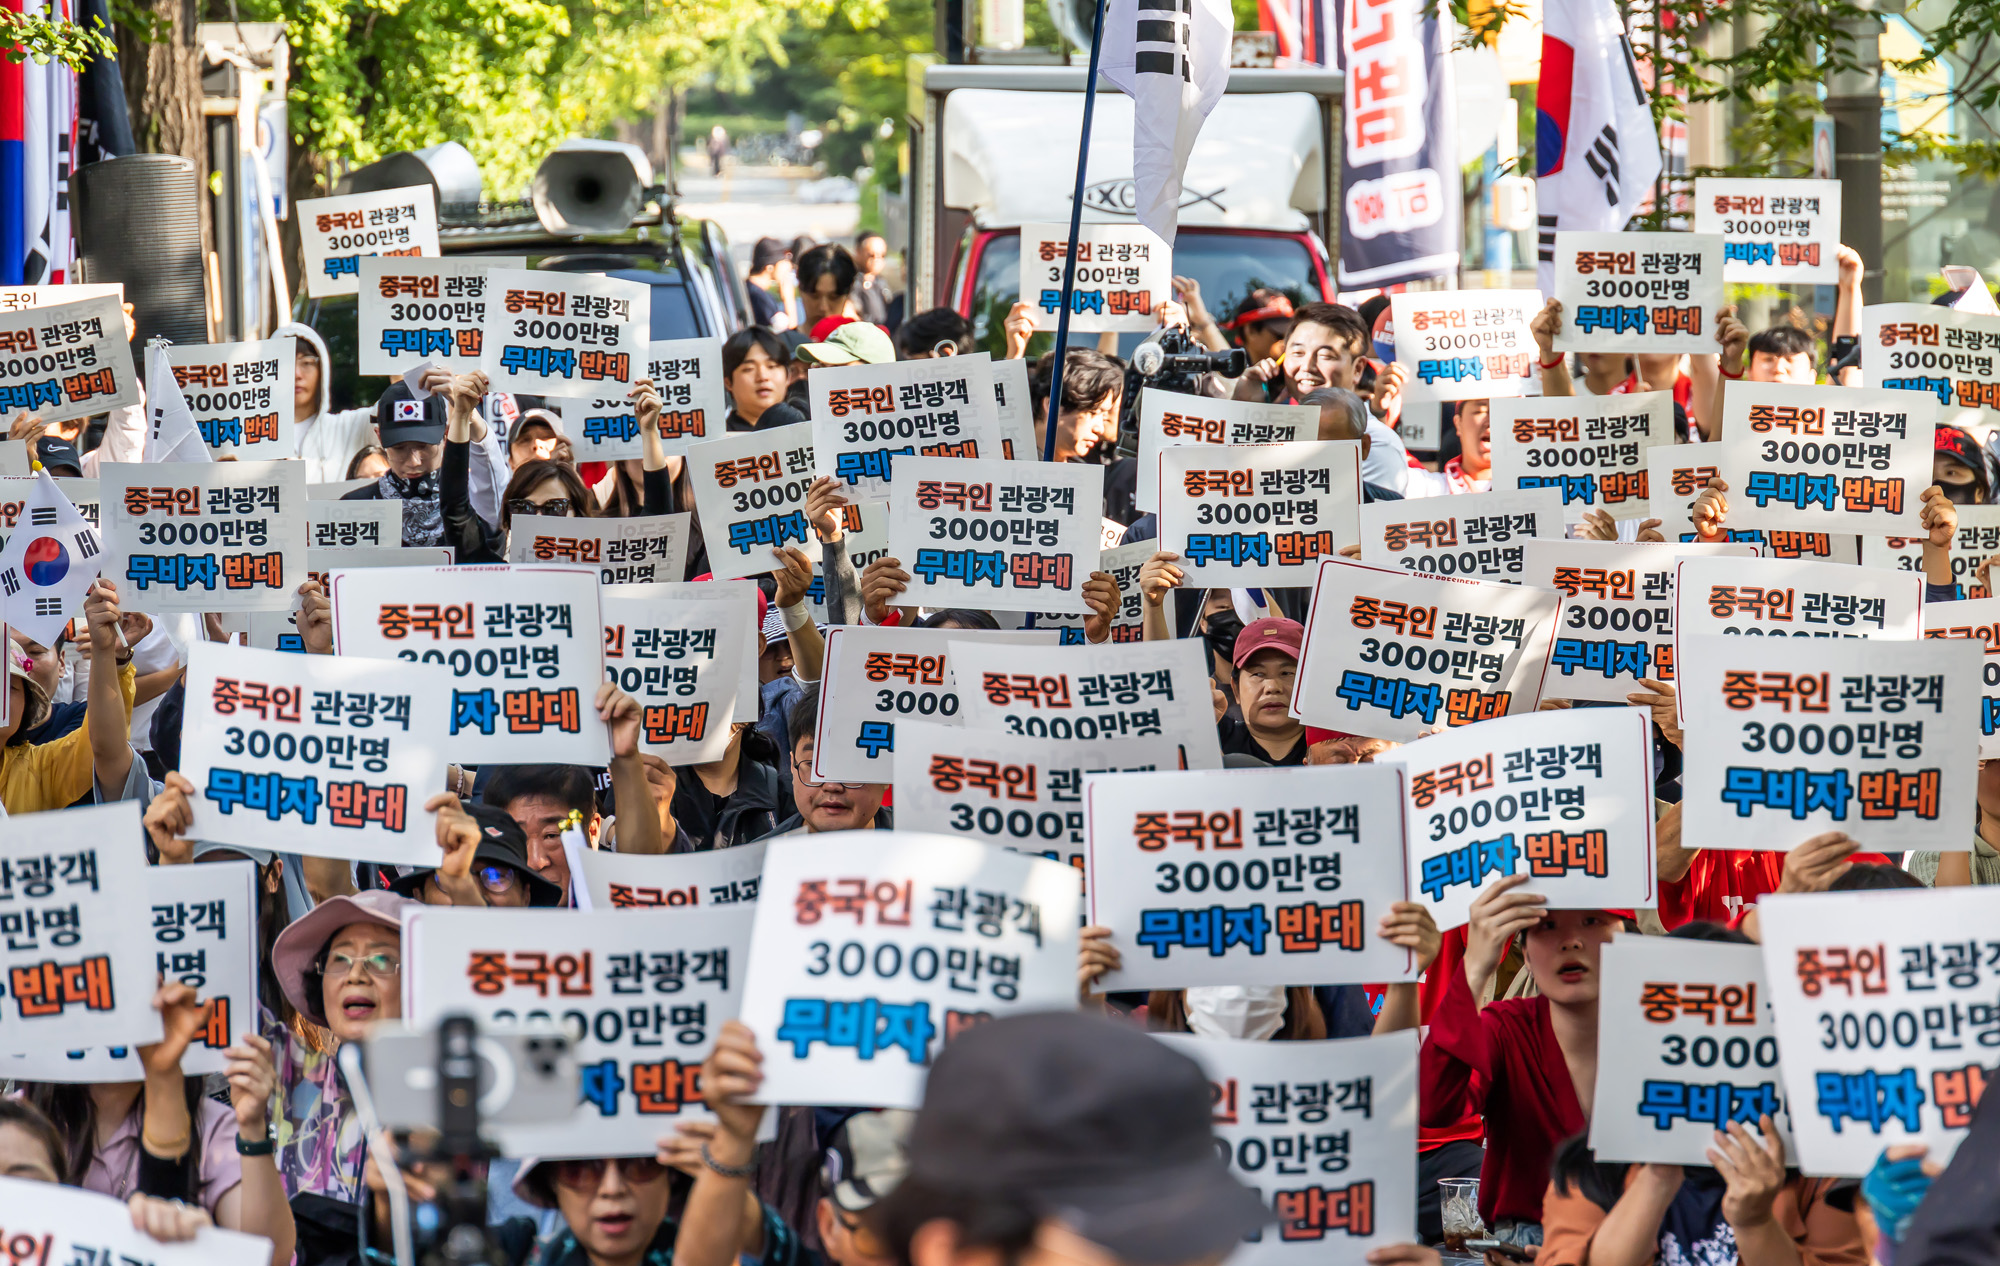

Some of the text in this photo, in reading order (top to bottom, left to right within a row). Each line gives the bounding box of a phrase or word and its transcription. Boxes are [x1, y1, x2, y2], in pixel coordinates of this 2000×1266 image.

[316, 204, 417, 233] 중국인 관광객
[1714, 195, 1820, 215] 중국인 관광객
[328, 228, 411, 250] 3000만명
[1723, 219, 1811, 237] 3000만명
[1097, 242, 1150, 262] 관광객
[1575, 251, 1702, 275] 중국인 관광객
[1779, 242, 1820, 266] 반대
[379, 274, 487, 298] 중국인 관광
[1049, 266, 1140, 285] 300만명
[1586, 279, 1690, 300] 3000만명
[504, 289, 630, 322] 중국인 관광객
[1107, 289, 1150, 316] 반대
[1412, 307, 1523, 331] 중국인 관광객
[1575, 305, 1702, 335] 무비자 반대
[41, 317, 104, 347] 관광객
[380, 328, 454, 357] 무비자
[513, 319, 619, 346] 3000만명
[1425, 330, 1516, 351] 3000만명
[1879, 323, 1940, 347] 중국인
[172, 359, 279, 388] 중국인 관광객
[500, 345, 630, 383] 무비자 반대
[1417, 352, 1532, 385] 무비자 반대
[1890, 352, 1993, 376] 3000만명
[62, 368, 117, 402] 반대
[828, 385, 895, 417] 중국인
[899, 379, 970, 408] 관광객
[243, 412, 279, 442] 반대
[659, 409, 705, 439] 반대
[843, 411, 961, 443] 3000만명
[1162, 413, 1225, 443] 중국인
[1513, 413, 1650, 442] 중국인 관광객
[1749, 405, 1825, 436] 중국인
[1832, 410, 1907, 440] 관광객
[715, 451, 781, 487] 중국인
[1526, 442, 1639, 470] 3000만명
[1761, 440, 1891, 470] 3000만명
[124, 485, 280, 516] 중국인 관광객
[916, 480, 1075, 516] 중국인 관광객
[1184, 467, 1330, 498] 중국인 관광객
[1600, 469, 1650, 503] 반대
[1745, 471, 1904, 515] 무비자 반대
[1197, 499, 1319, 526] 3000만명
[138, 519, 268, 547] 3000만명
[315, 521, 379, 546] 관광객
[532, 535, 668, 563] 중국인 관광객
[729, 510, 808, 555] 무비자
[930, 517, 1060, 547] 3000만명
[1186, 530, 1333, 568] 무비자 반대
[1384, 512, 1537, 551] 중국인 관광객
[126, 553, 219, 591] 무비자
[222, 551, 283, 590] 반대
[914, 548, 1007, 588] 무비자
[1010, 552, 1074, 592] 반대
[1552, 568, 1635, 600] 중국인
[378, 603, 573, 640] 중국인 관광객
[1350, 596, 1525, 649] 중국인 관광객
[1708, 585, 1795, 622] 중국인
[1801, 592, 1886, 630] 관광객
[632, 628, 716, 660] 관광객
[1358, 638, 1505, 682] 3000만명
[1551, 640, 1650, 679] 무비자
[865, 652, 945, 686] 중국인
[212, 677, 301, 724] 중국인
[311, 690, 412, 731] 관광객
[983, 669, 1174, 709] 중국인 관광객
[1336, 670, 1442, 725] 무비자
[1722, 671, 1830, 713] 중국인
[1839, 675, 1944, 713] 관광객
[503, 686, 581, 734] 반대
[643, 702, 709, 745] 반대
[224, 727, 390, 774] 3000만명
[1742, 721, 1923, 760] 3000만명
[930, 754, 1037, 802] 중국인
[1411, 742, 1602, 809] 중국인 관광객
[1721, 765, 1941, 822] 무비자 반대
[205, 767, 407, 833] 무비자 반대
[1429, 785, 1586, 841] 3000만명
[1133, 803, 1360, 852] 중국인 관광객
[1155, 852, 1343, 893] 3000만명
[1421, 829, 1608, 902] 무비자 반대
[796, 878, 914, 926] 중국인
[926, 886, 1046, 948] 관광객
[1136, 899, 1366, 960] 무비자 반대
[9, 954, 116, 1018] 반대
[467, 947, 730, 998] 중국인 관광객
[806, 941, 1020, 1002] 3000만명
[1797, 944, 1889, 1000] 중국인
[1640, 982, 1757, 1026] 중국인
[776, 996, 936, 1066] 무비자
[1249, 1076, 1376, 1125] 관광객
[1638, 1079, 1781, 1134] 무비자
[1816, 1069, 1926, 1134] 무비자
[1273, 1180, 1378, 1243] 반대
